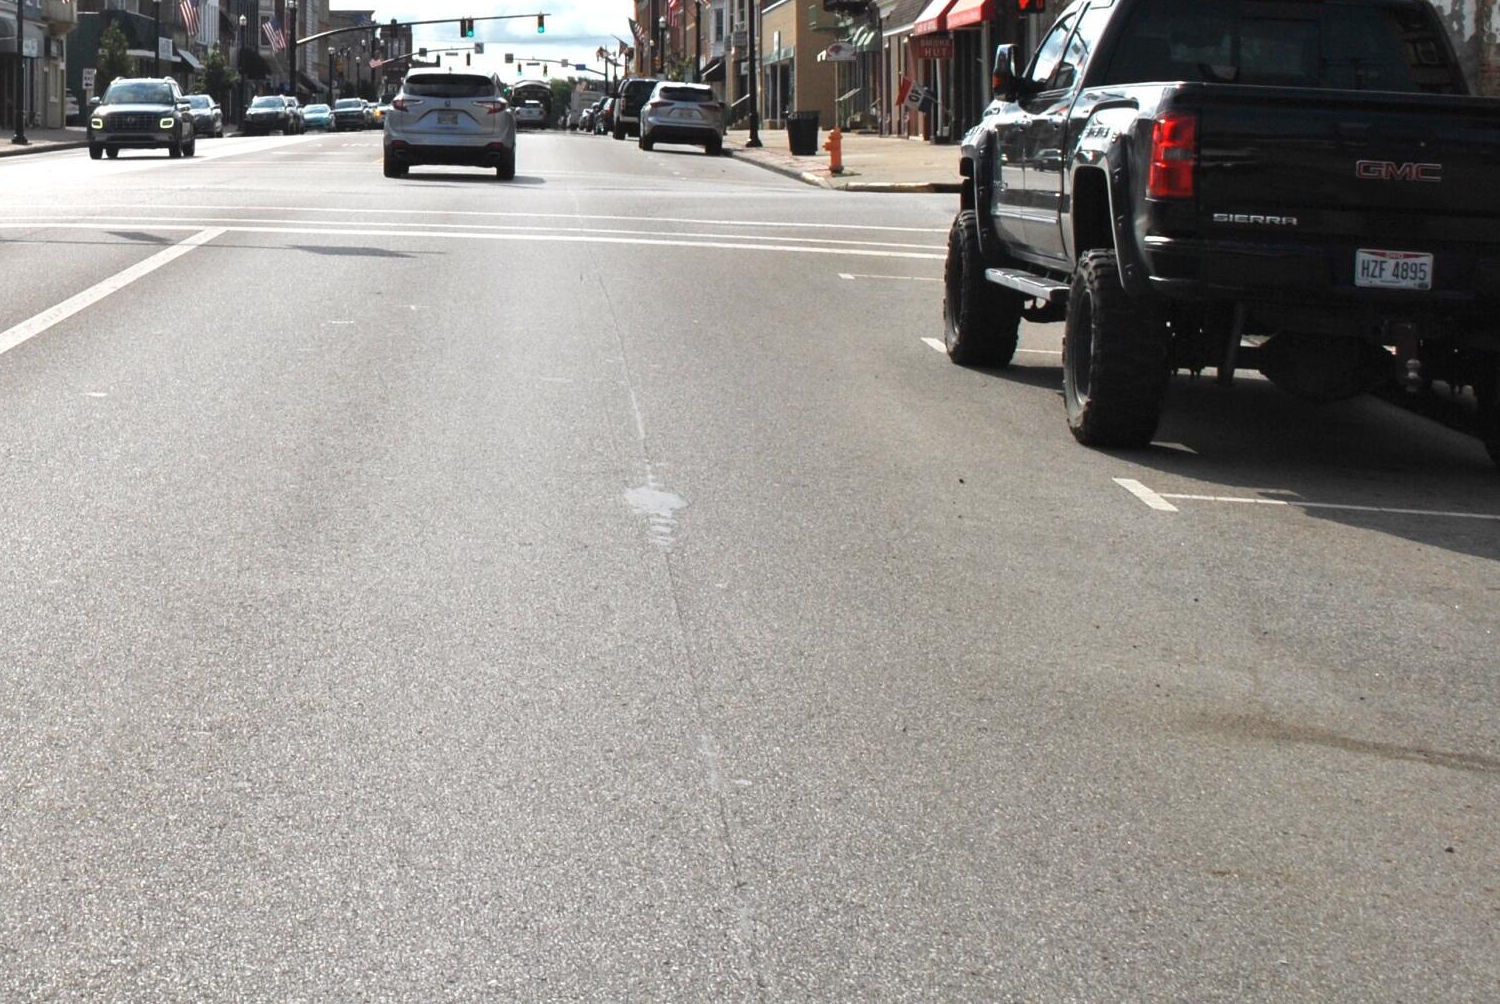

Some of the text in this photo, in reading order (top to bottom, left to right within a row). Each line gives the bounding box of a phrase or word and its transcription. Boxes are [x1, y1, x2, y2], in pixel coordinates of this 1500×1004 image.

[925, 47, 948, 56] HUT
[1356, 160, 1442, 182] GMC
[1213, 213, 1297, 225] SIERRA
[1361, 259, 1428, 281] HZF 4895
